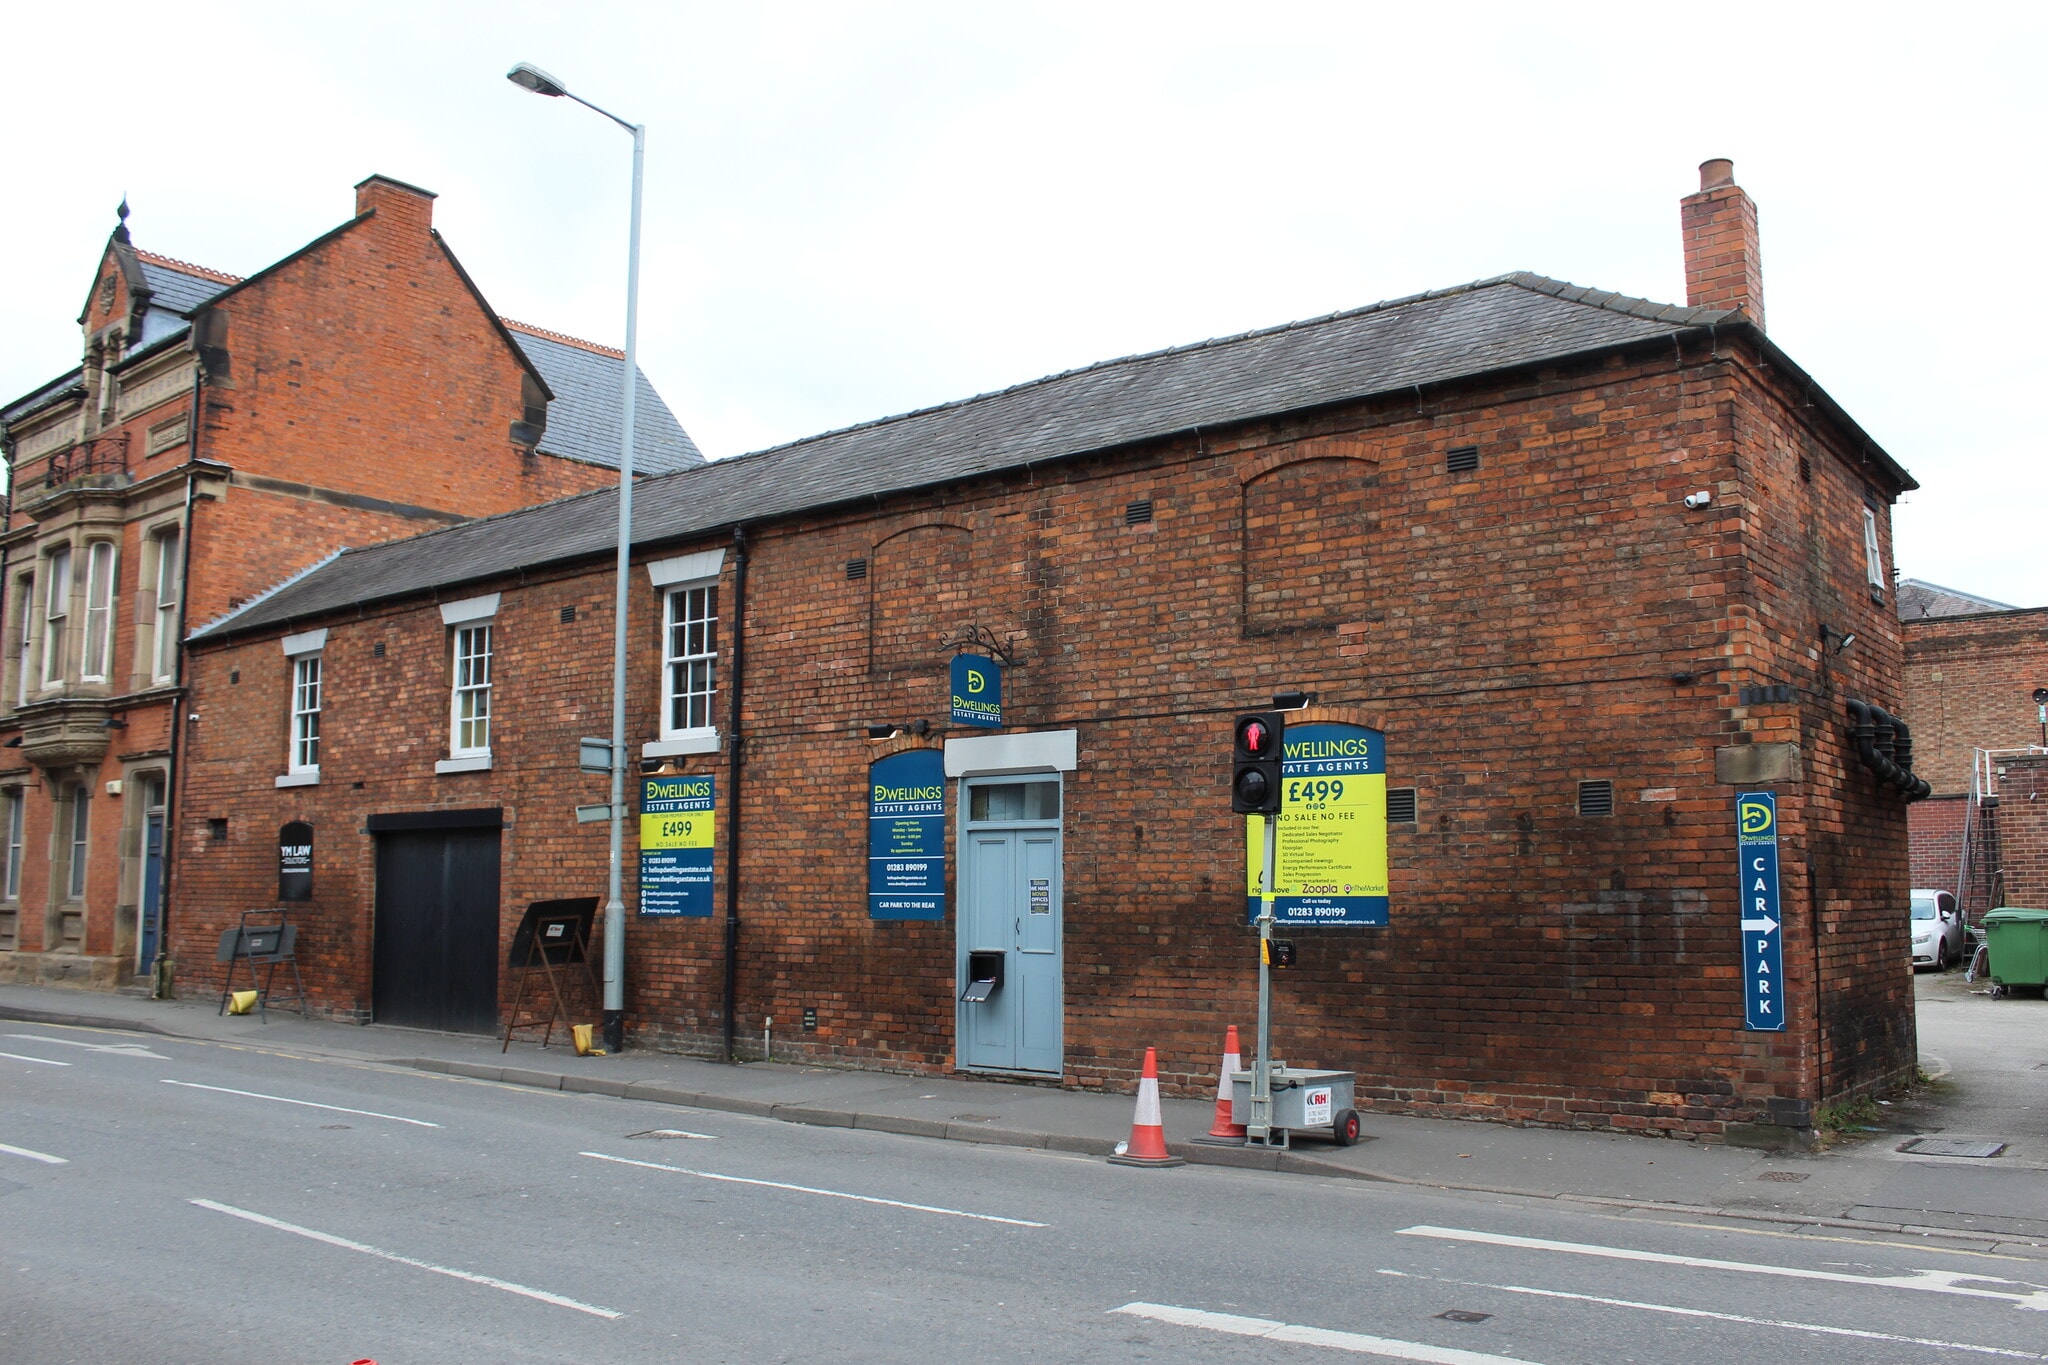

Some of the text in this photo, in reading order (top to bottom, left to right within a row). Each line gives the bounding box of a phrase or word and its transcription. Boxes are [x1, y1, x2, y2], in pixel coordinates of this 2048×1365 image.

[953, 696, 1000, 714] DWELLINGS
[1284, 738, 1368, 758] WELLINGS
[1282, 761, 1368, 774] TATE AGENTS
[647, 782, 710, 799] DWELLINGS
[874, 785, 942, 802] DWELLINGS
[1289, 780, 1344, 802] £499
[647, 801, 710, 811] ESTATE AGENTS
[663, 821, 692, 836] £499
[281, 845, 311, 856] YM LAW
[1302, 884, 1338, 895] Zoopla
[1288, 907, 1346, 916] 01283 890199
[1753, 858, 1771, 1013] CAR PARK
[1315, 1094, 1326, 1105] RH
